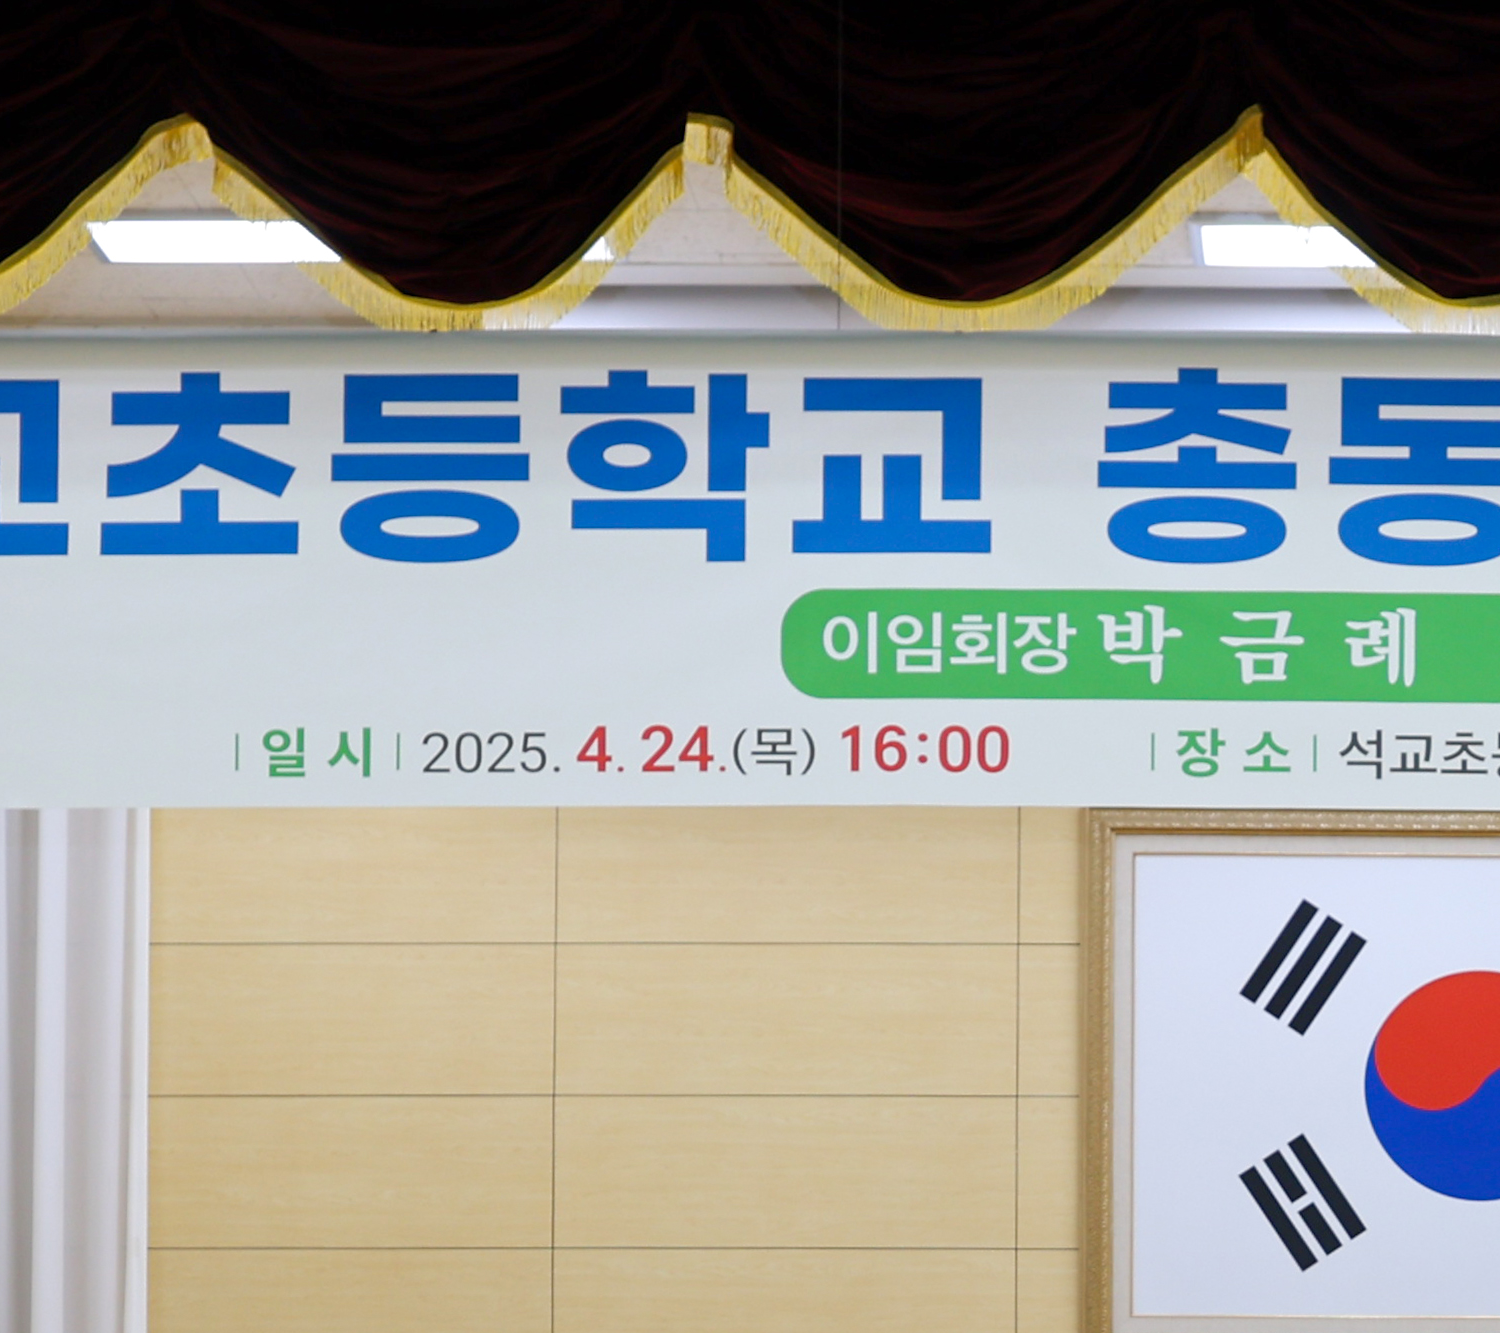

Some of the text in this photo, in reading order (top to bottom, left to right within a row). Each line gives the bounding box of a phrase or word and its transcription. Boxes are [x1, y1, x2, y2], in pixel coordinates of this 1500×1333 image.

[823, 611, 1077, 675] 이임회장
[422, 732, 562, 773] 2025.
[841, 725, 1010, 773] 16:00
